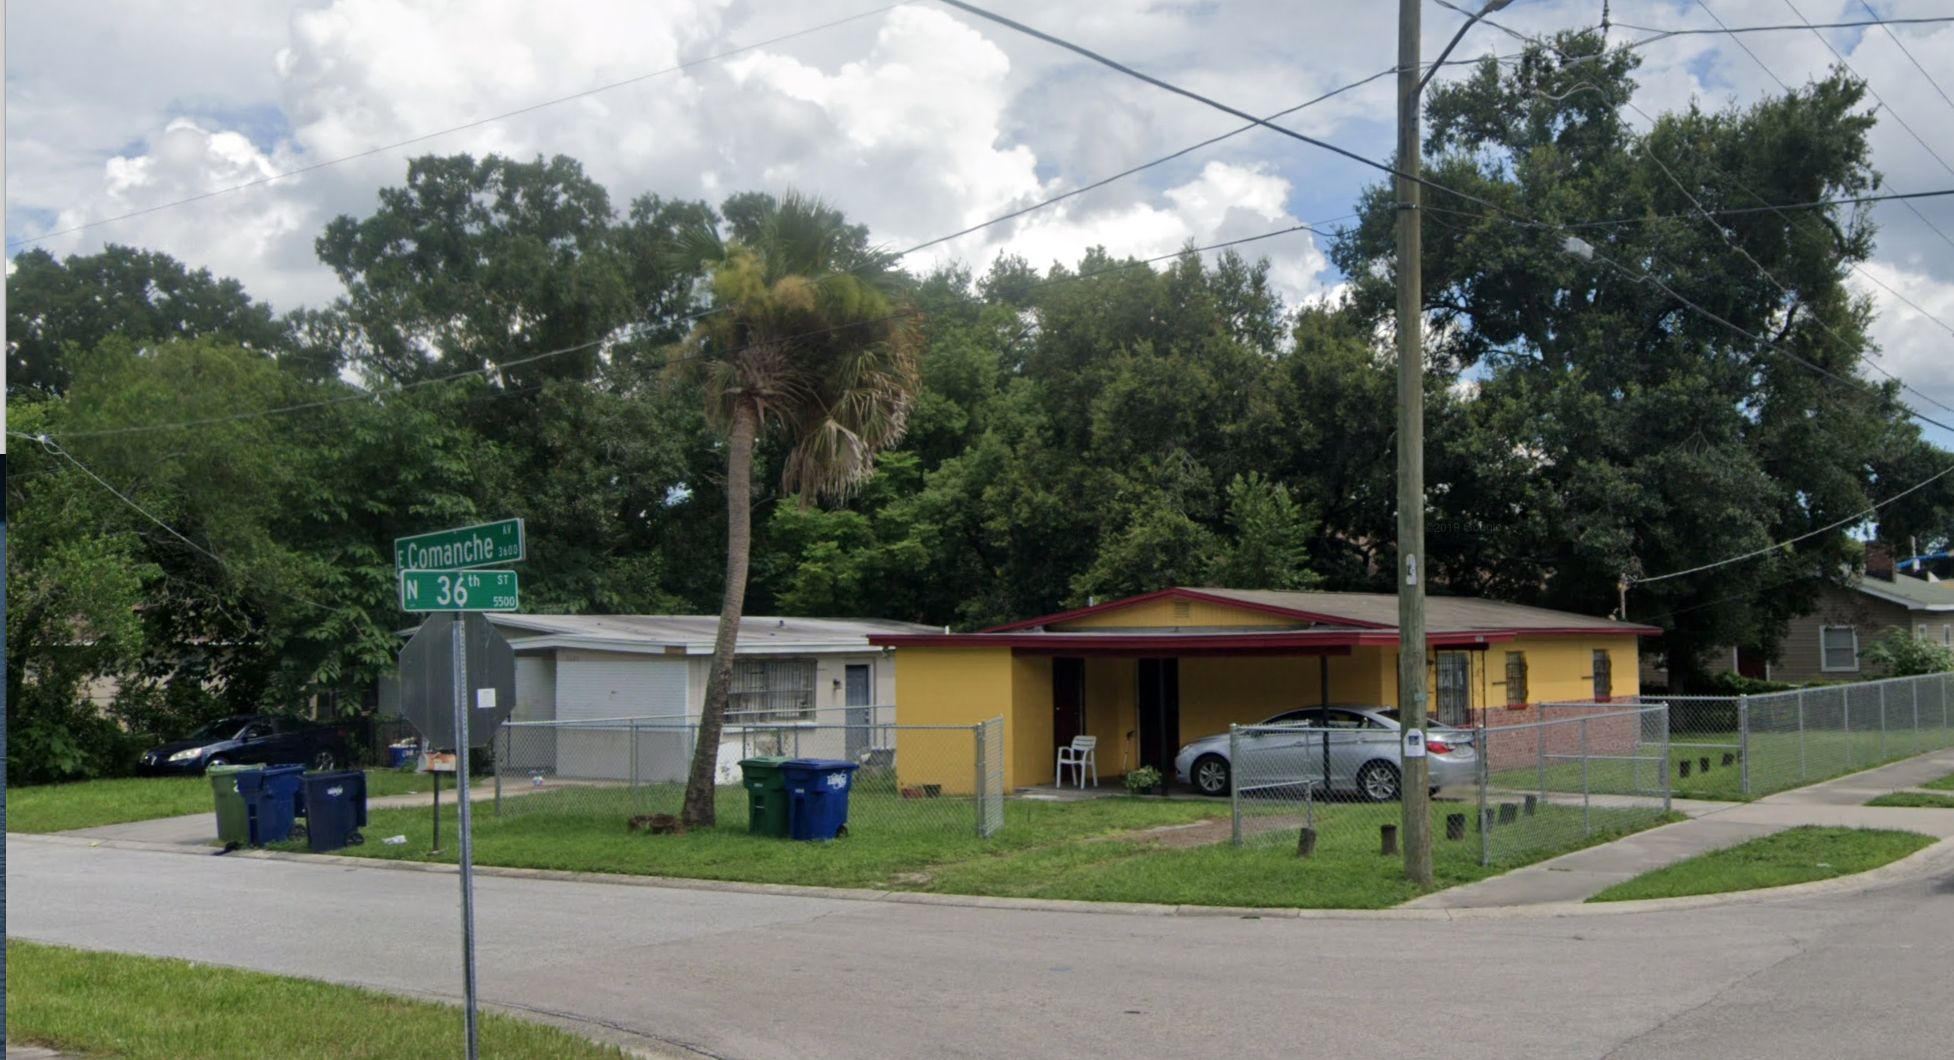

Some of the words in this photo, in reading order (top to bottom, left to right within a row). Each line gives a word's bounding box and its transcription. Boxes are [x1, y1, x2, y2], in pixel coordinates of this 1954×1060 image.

[502, 524, 512, 535] AV
[398, 550, 404, 569] E
[408, 533, 494, 569] Comanche
[498, 544, 518, 557] 3600
[406, 579, 418, 600] N
[497, 575, 509, 585] ST
[493, 596, 515, 607] 5500
